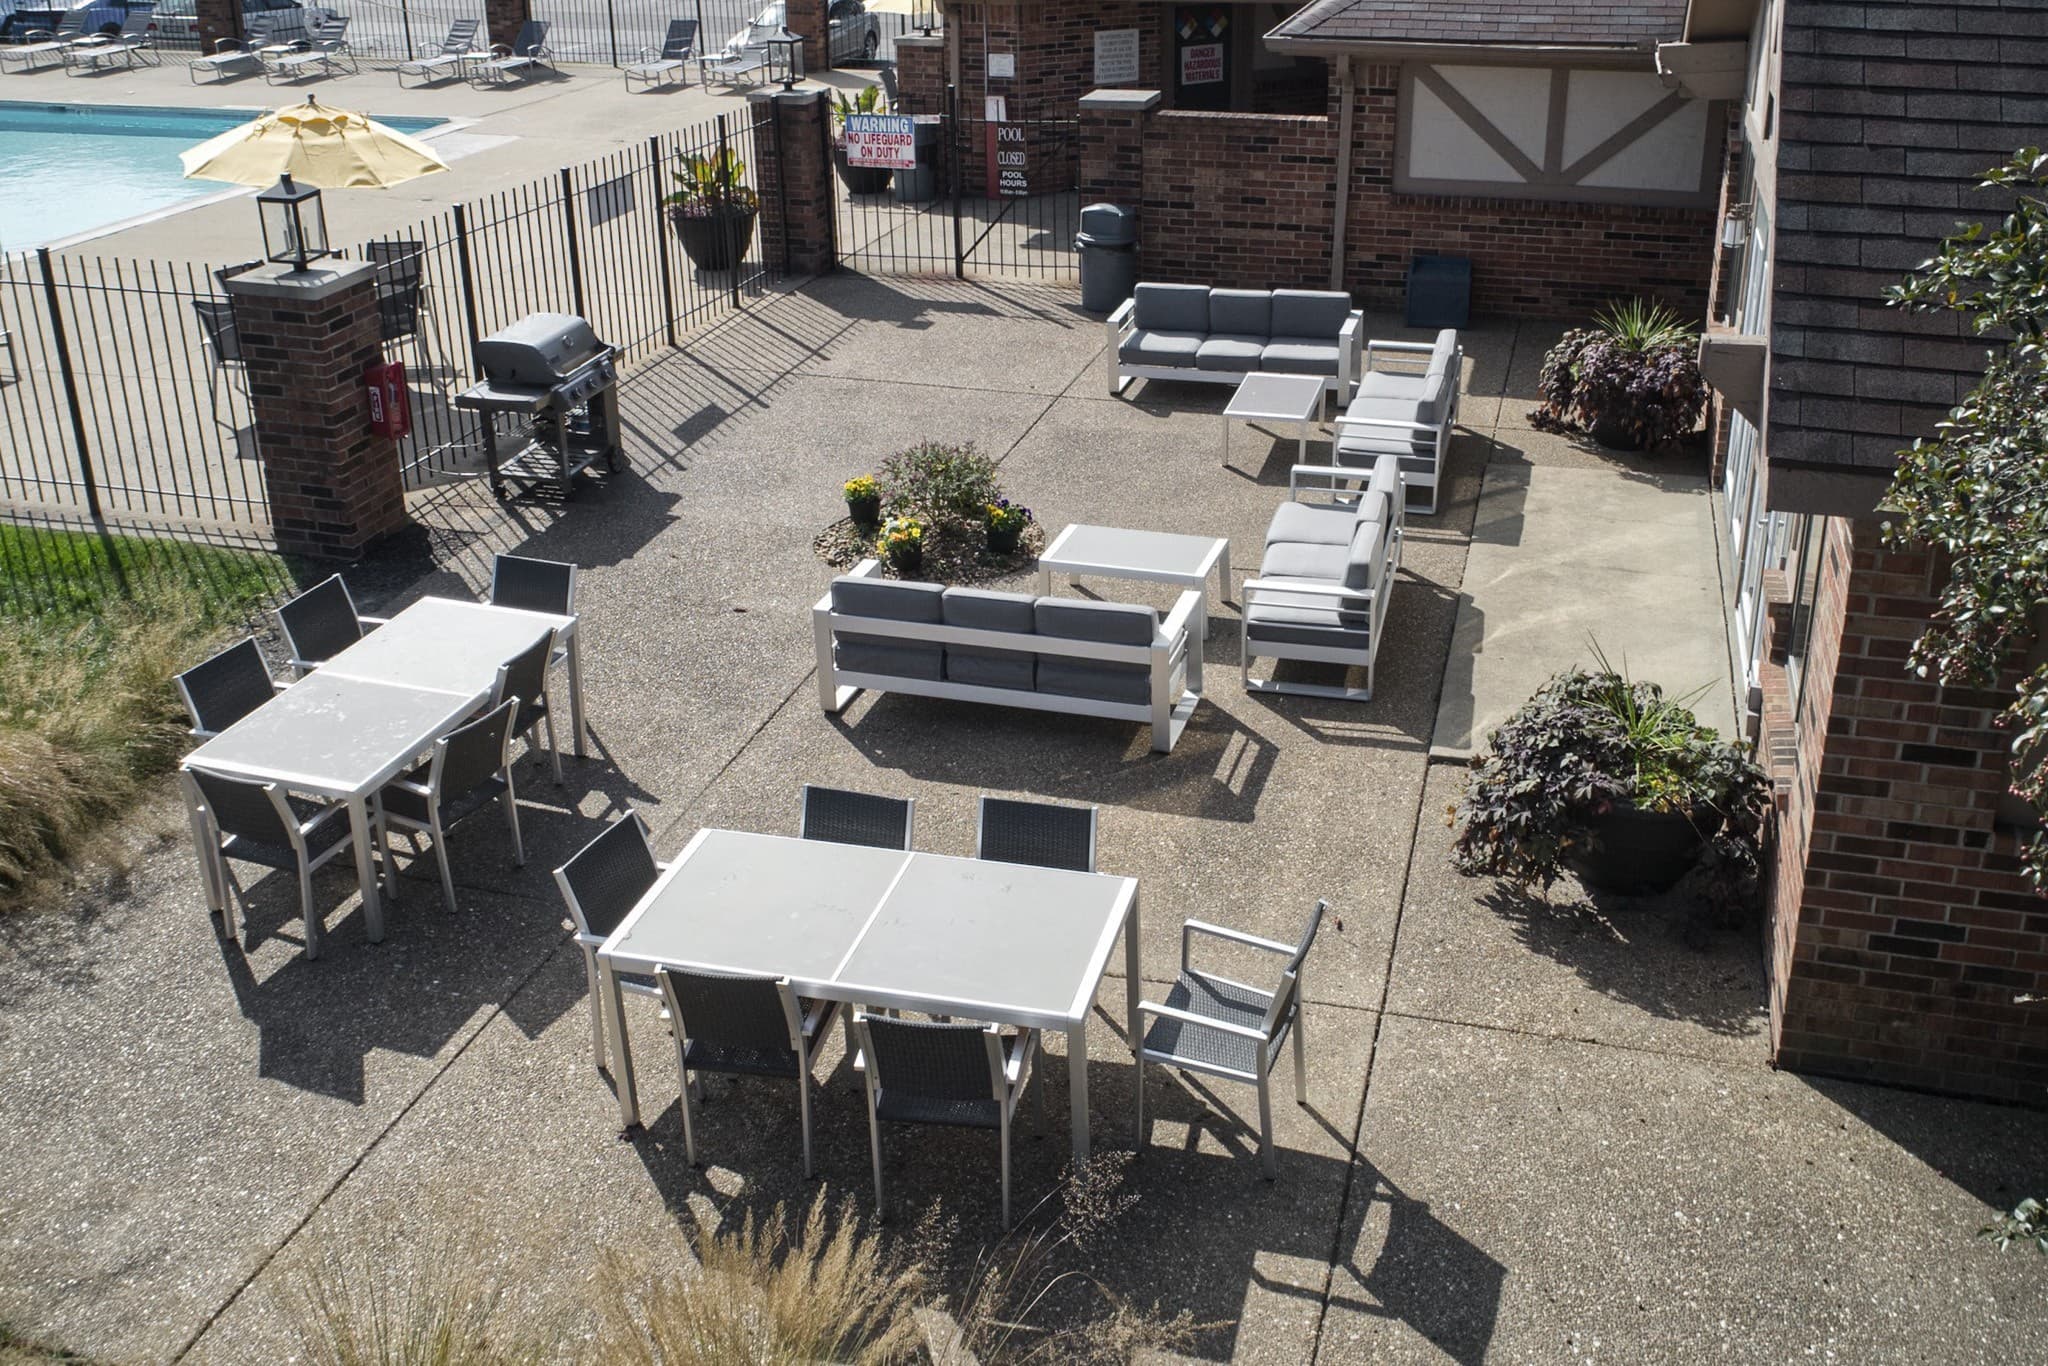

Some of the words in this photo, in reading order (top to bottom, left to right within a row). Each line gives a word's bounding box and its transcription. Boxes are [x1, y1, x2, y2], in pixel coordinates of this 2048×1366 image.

[1190, 47, 1215, 59] DANGER
[850, 117, 909, 132] WARNING
[848, 133, 860, 144] NO
[863, 134, 912, 146] LIFEGUARD
[998, 127, 1025, 141] POOL
[861, 146, 873, 158] ON
[876, 146, 900, 158] DUTY
[997, 151, 1025, 165] CLOSED
[1002, 171, 1024, 179] POOL
[1000, 179, 1027, 187] HOURS
